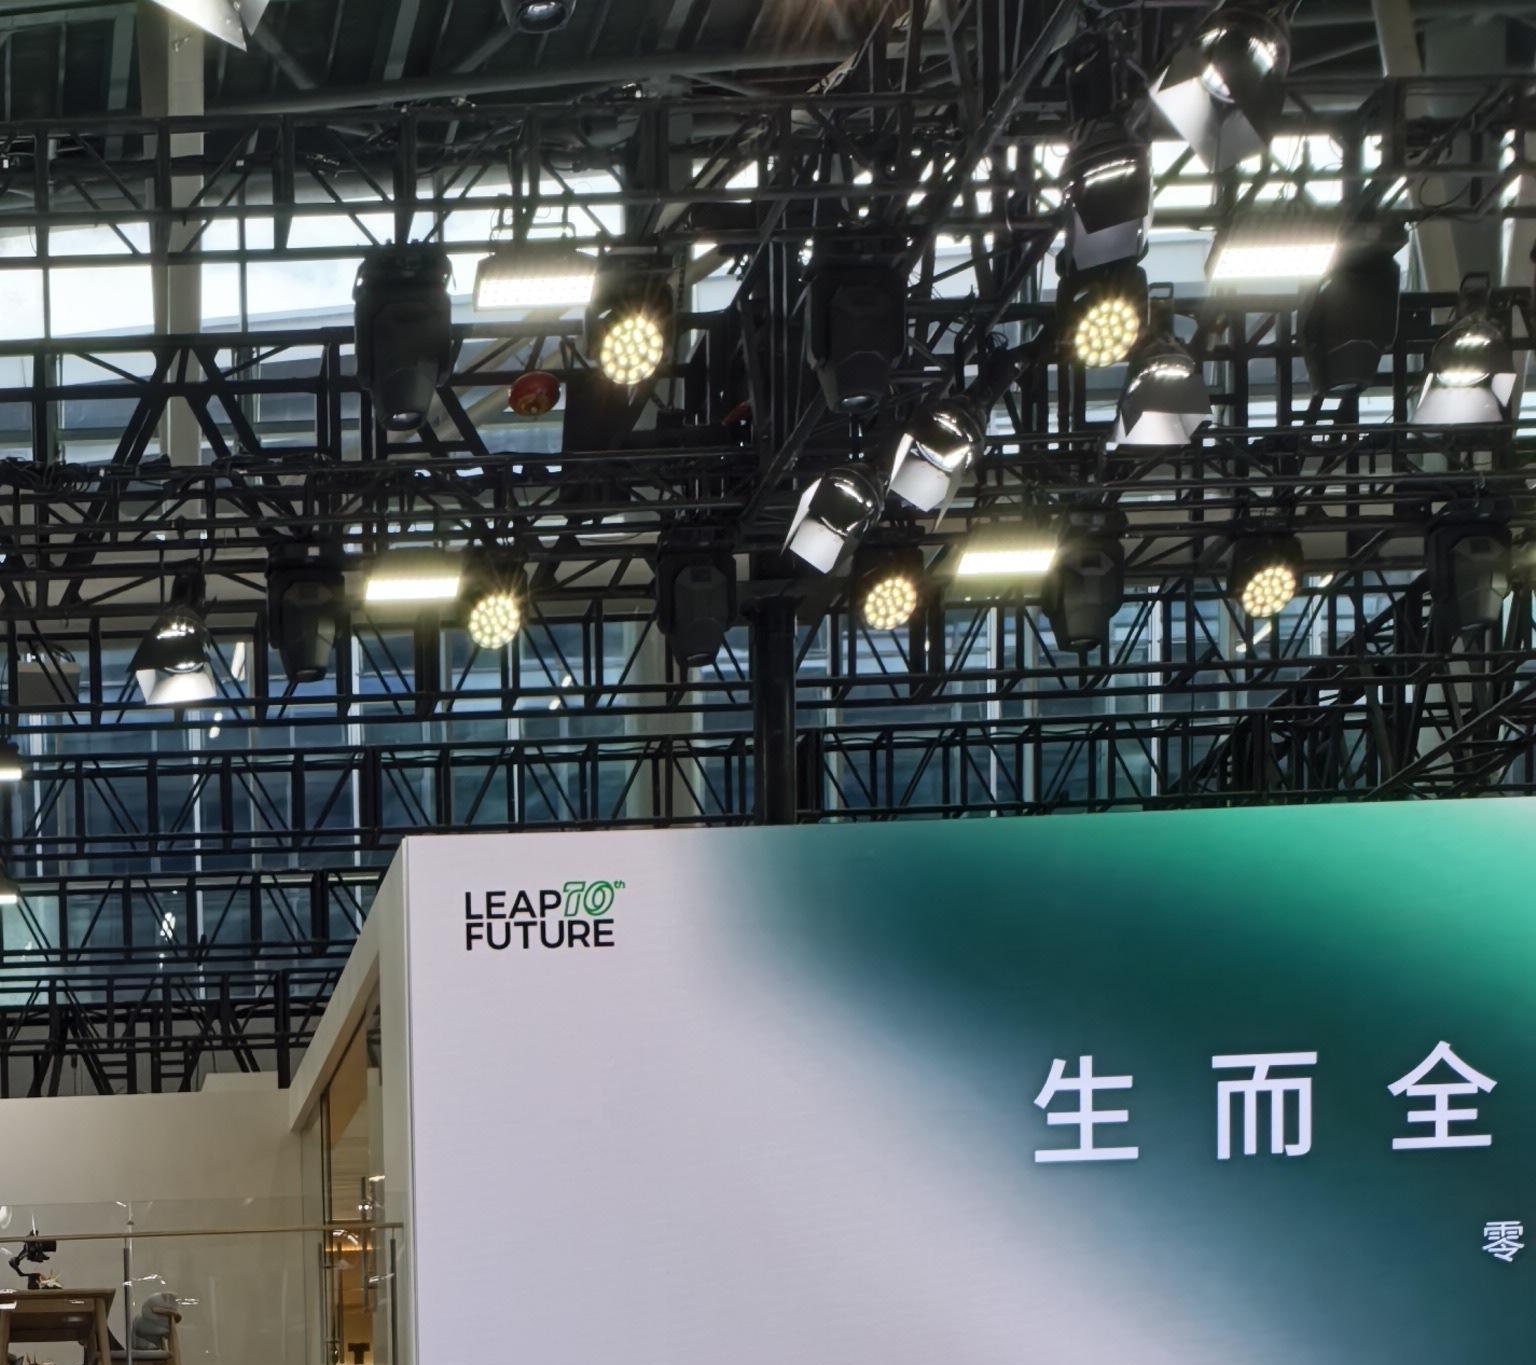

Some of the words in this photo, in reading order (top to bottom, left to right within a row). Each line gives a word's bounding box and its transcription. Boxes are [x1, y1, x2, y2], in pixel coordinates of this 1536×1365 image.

[465, 889, 562, 920] LEAP
[465, 918, 615, 951] FUTURE
[1482, 1221, 1525, 1262] 零
